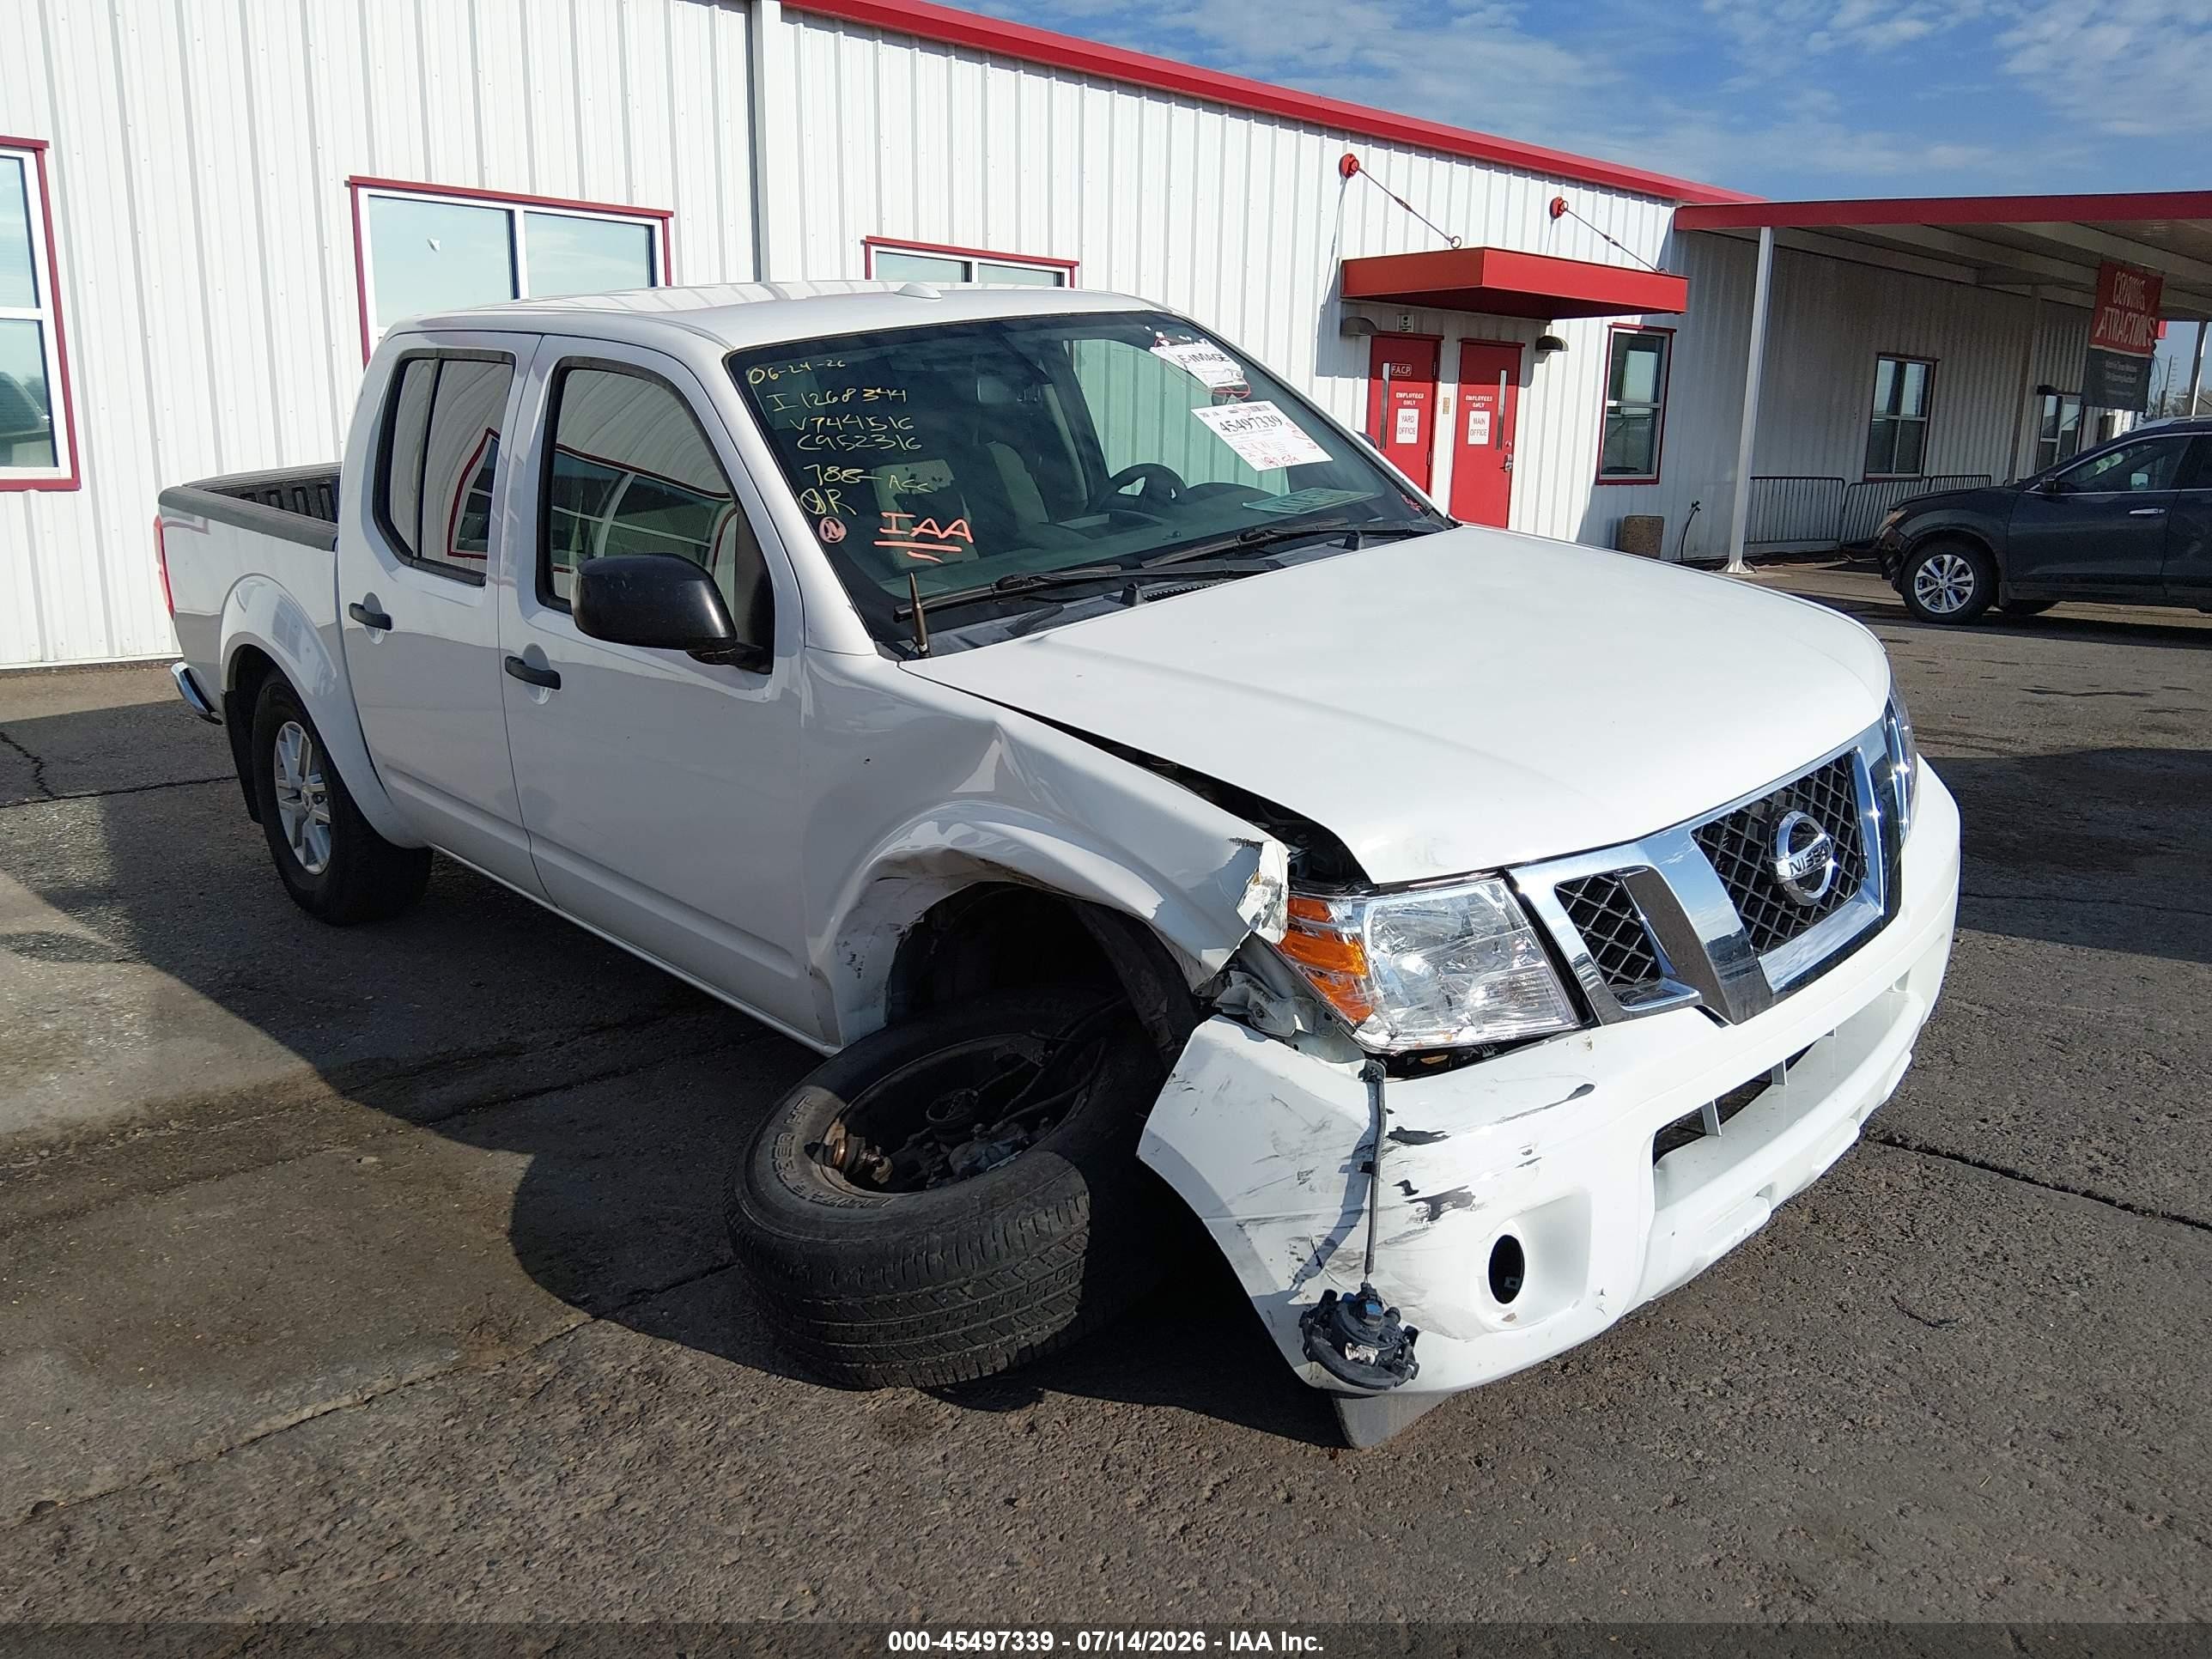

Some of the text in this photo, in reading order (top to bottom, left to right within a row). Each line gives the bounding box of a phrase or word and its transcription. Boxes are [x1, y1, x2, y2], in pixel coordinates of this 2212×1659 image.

[2112, 270, 2146, 311] COMING
[2095, 307, 2156, 347] ATTRACTIONS
[1219, 416, 1283, 433] 45497339
[1398, 427, 1416, 435] OFFICE
[1401, 415, 1415, 423] YARD
[879, 512, 974, 544] IAA
